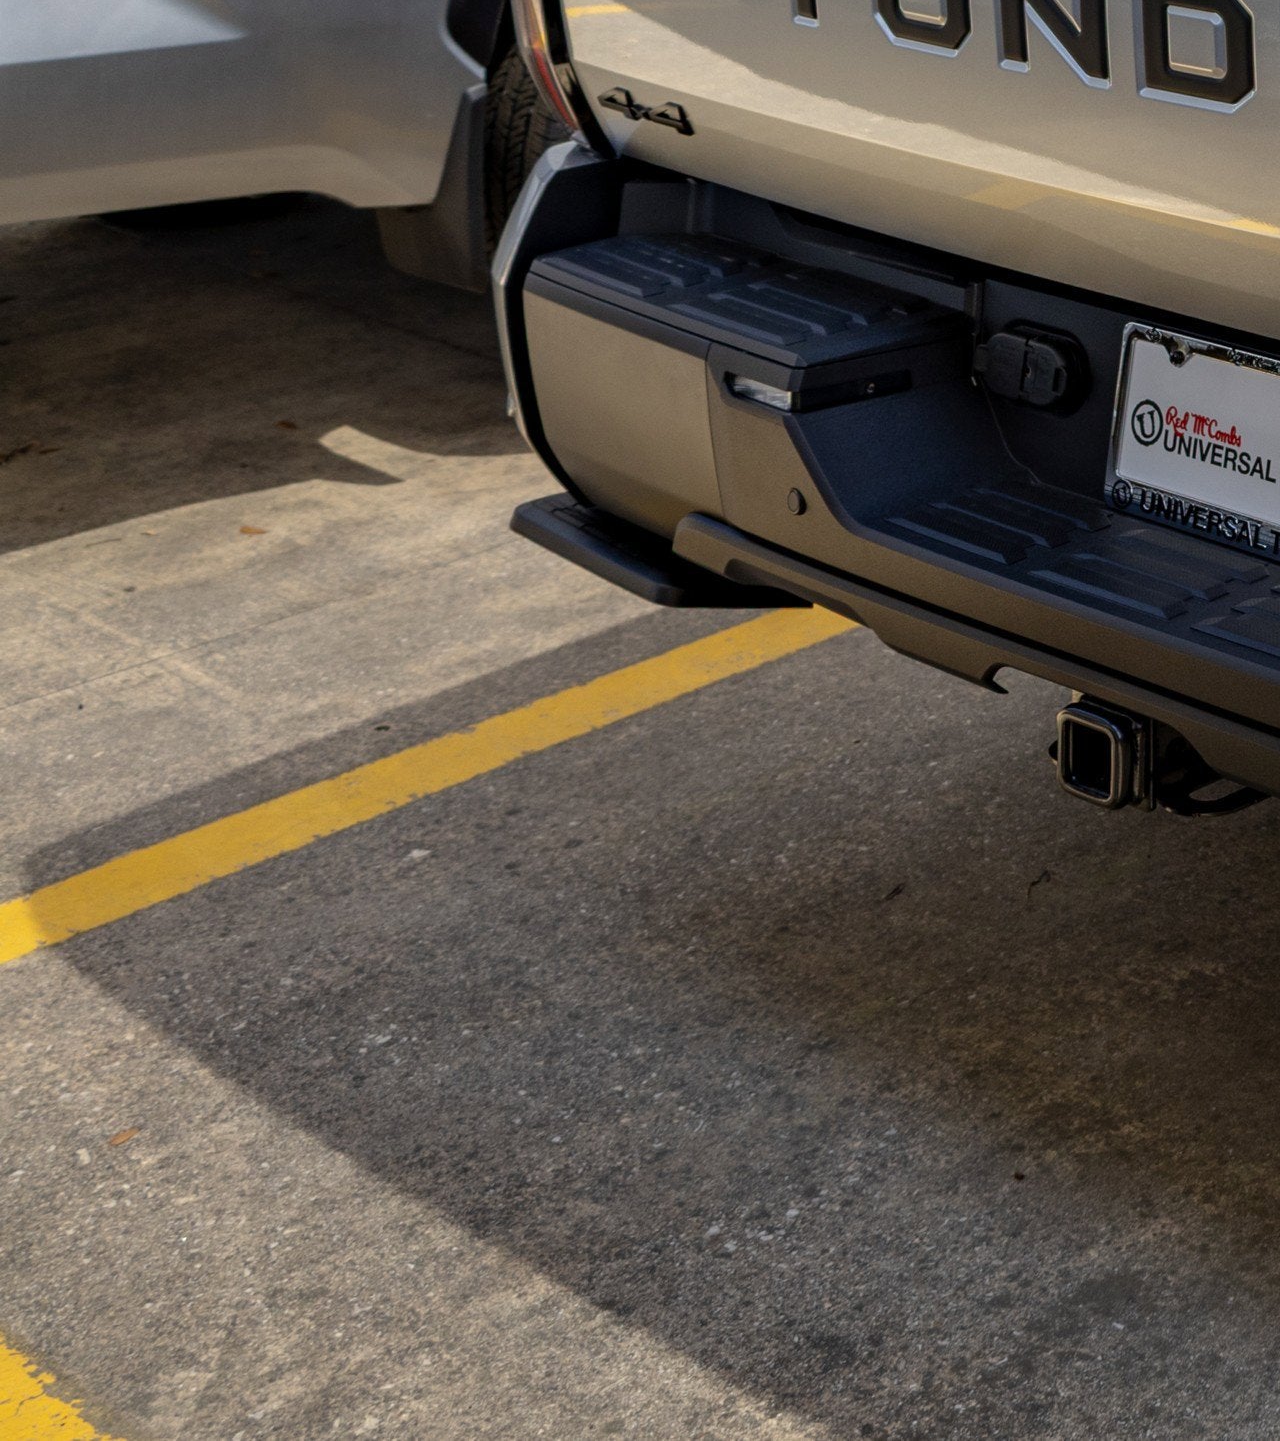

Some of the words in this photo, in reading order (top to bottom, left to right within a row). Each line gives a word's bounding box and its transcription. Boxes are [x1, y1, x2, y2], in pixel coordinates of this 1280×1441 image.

[1165, 406, 1190, 437] Red
[1163, 429, 1276, 484] UNIVERSAL
[1139, 487, 1267, 549] UNIVERSAL
